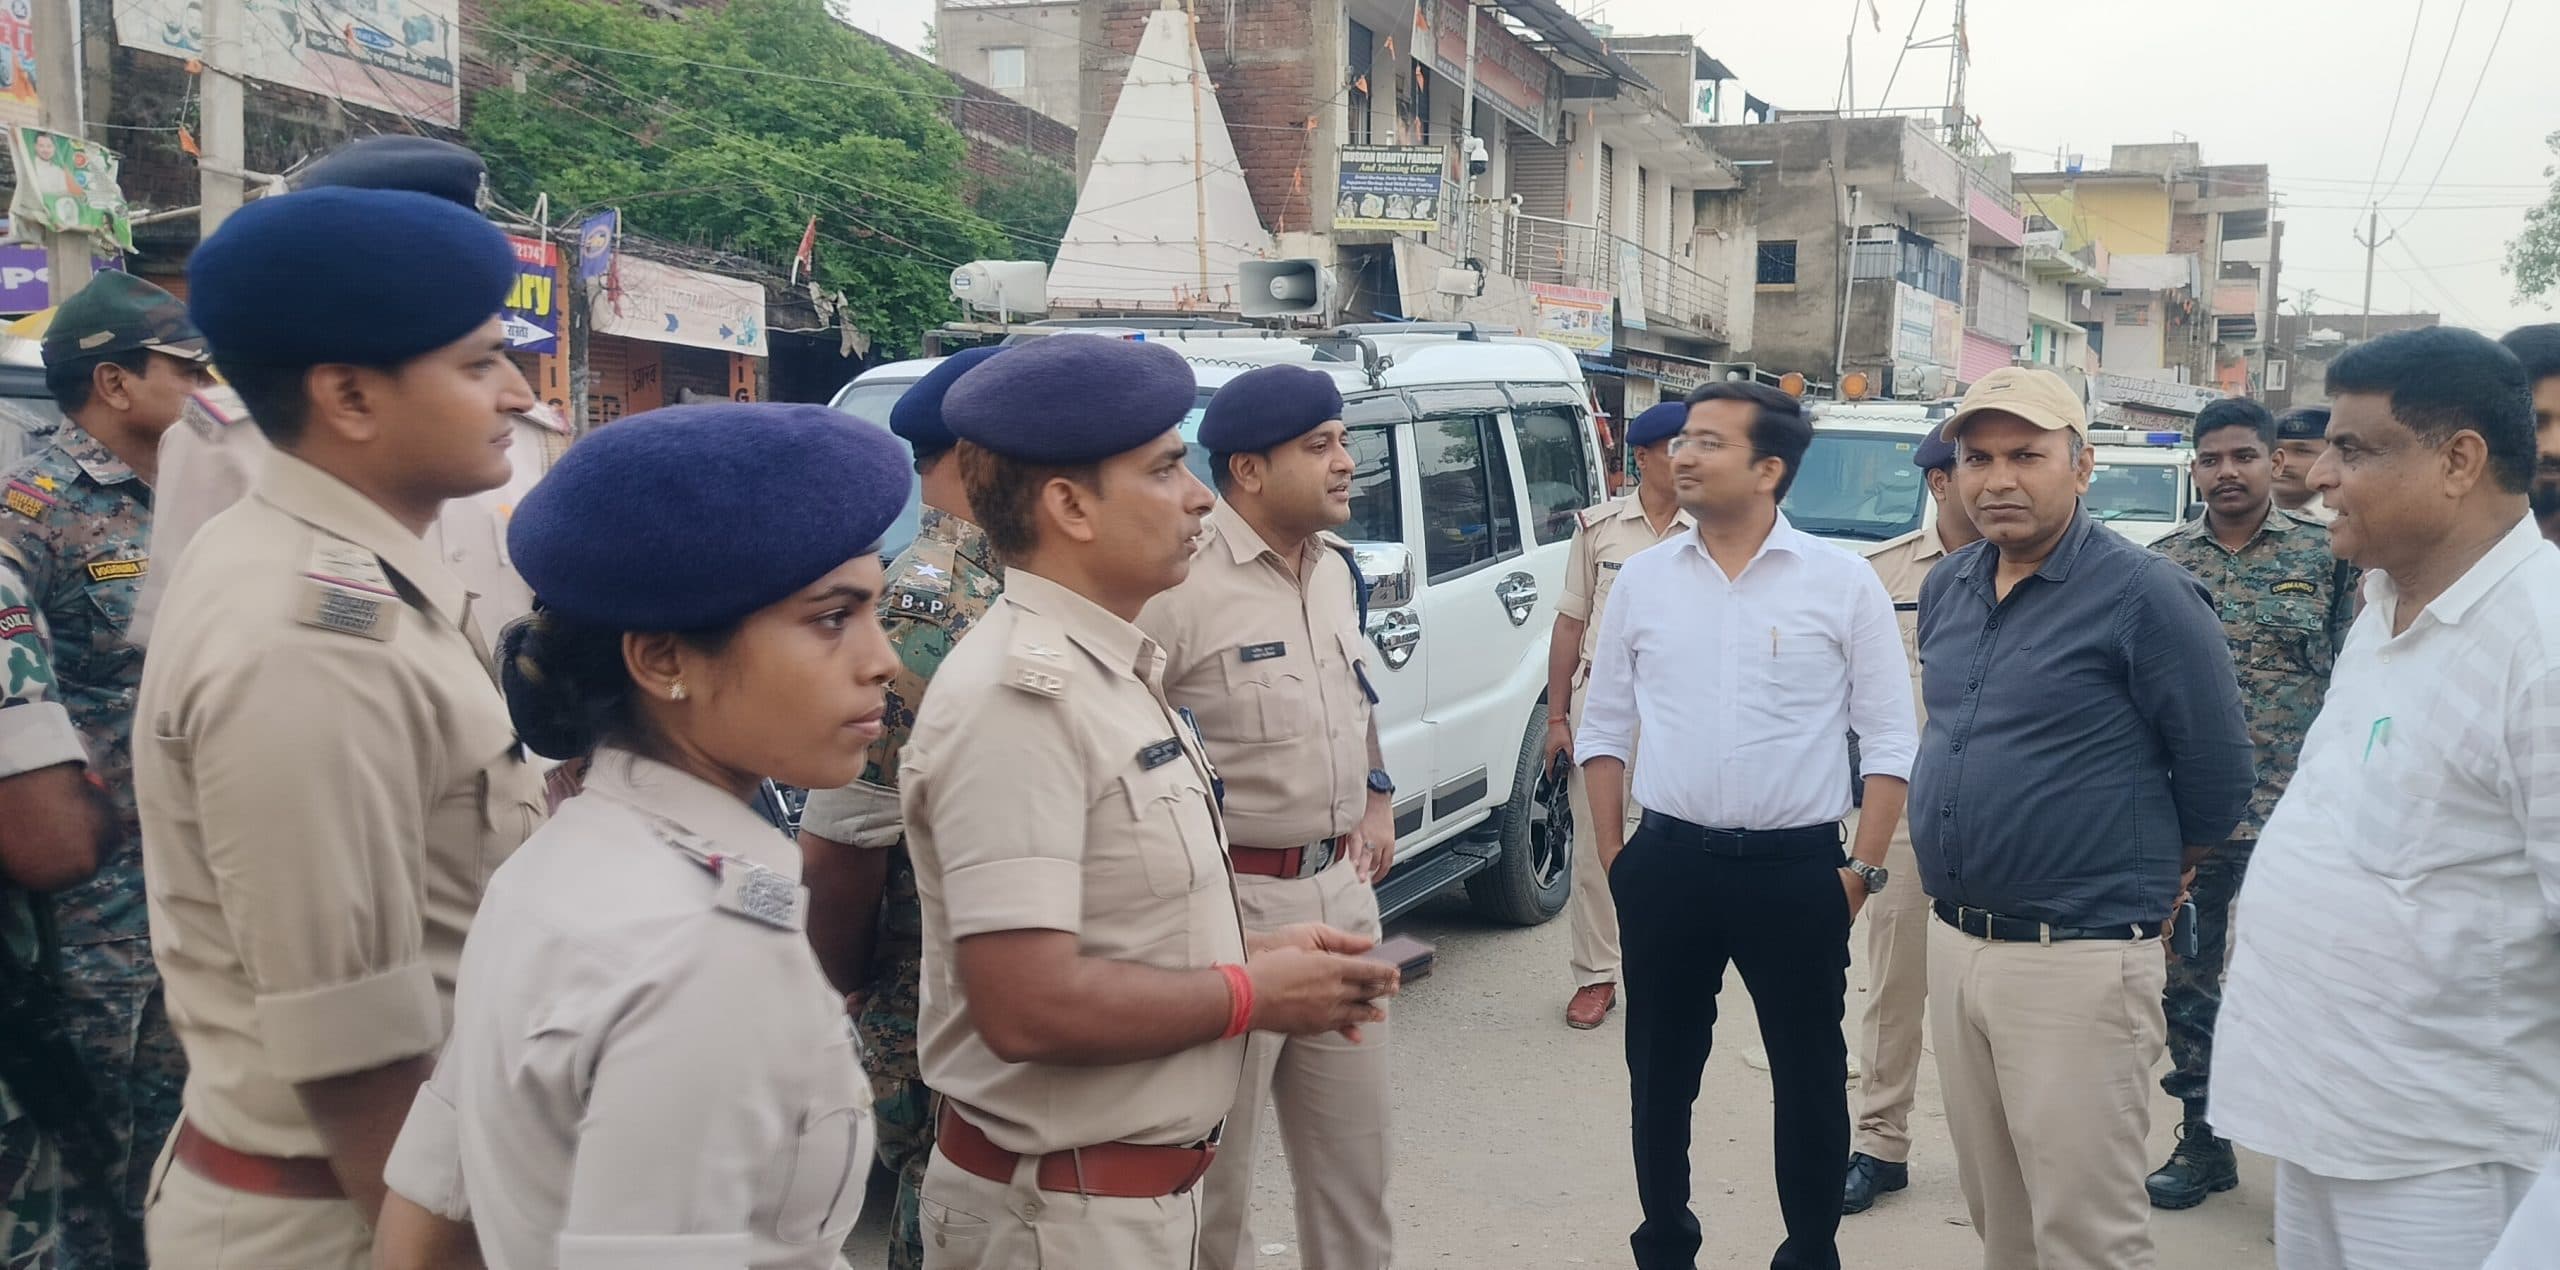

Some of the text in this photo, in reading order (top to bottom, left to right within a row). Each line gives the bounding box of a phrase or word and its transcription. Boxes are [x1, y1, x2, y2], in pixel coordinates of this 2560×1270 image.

[1376, 152, 1406, 163] BEAUTY
[1359, 163, 1376, 172] And
[1410, 165, 1438, 173] Center
[2116, 392, 2176, 407] SWEETS
[2272, 582, 2313, 593] COMMANDO
